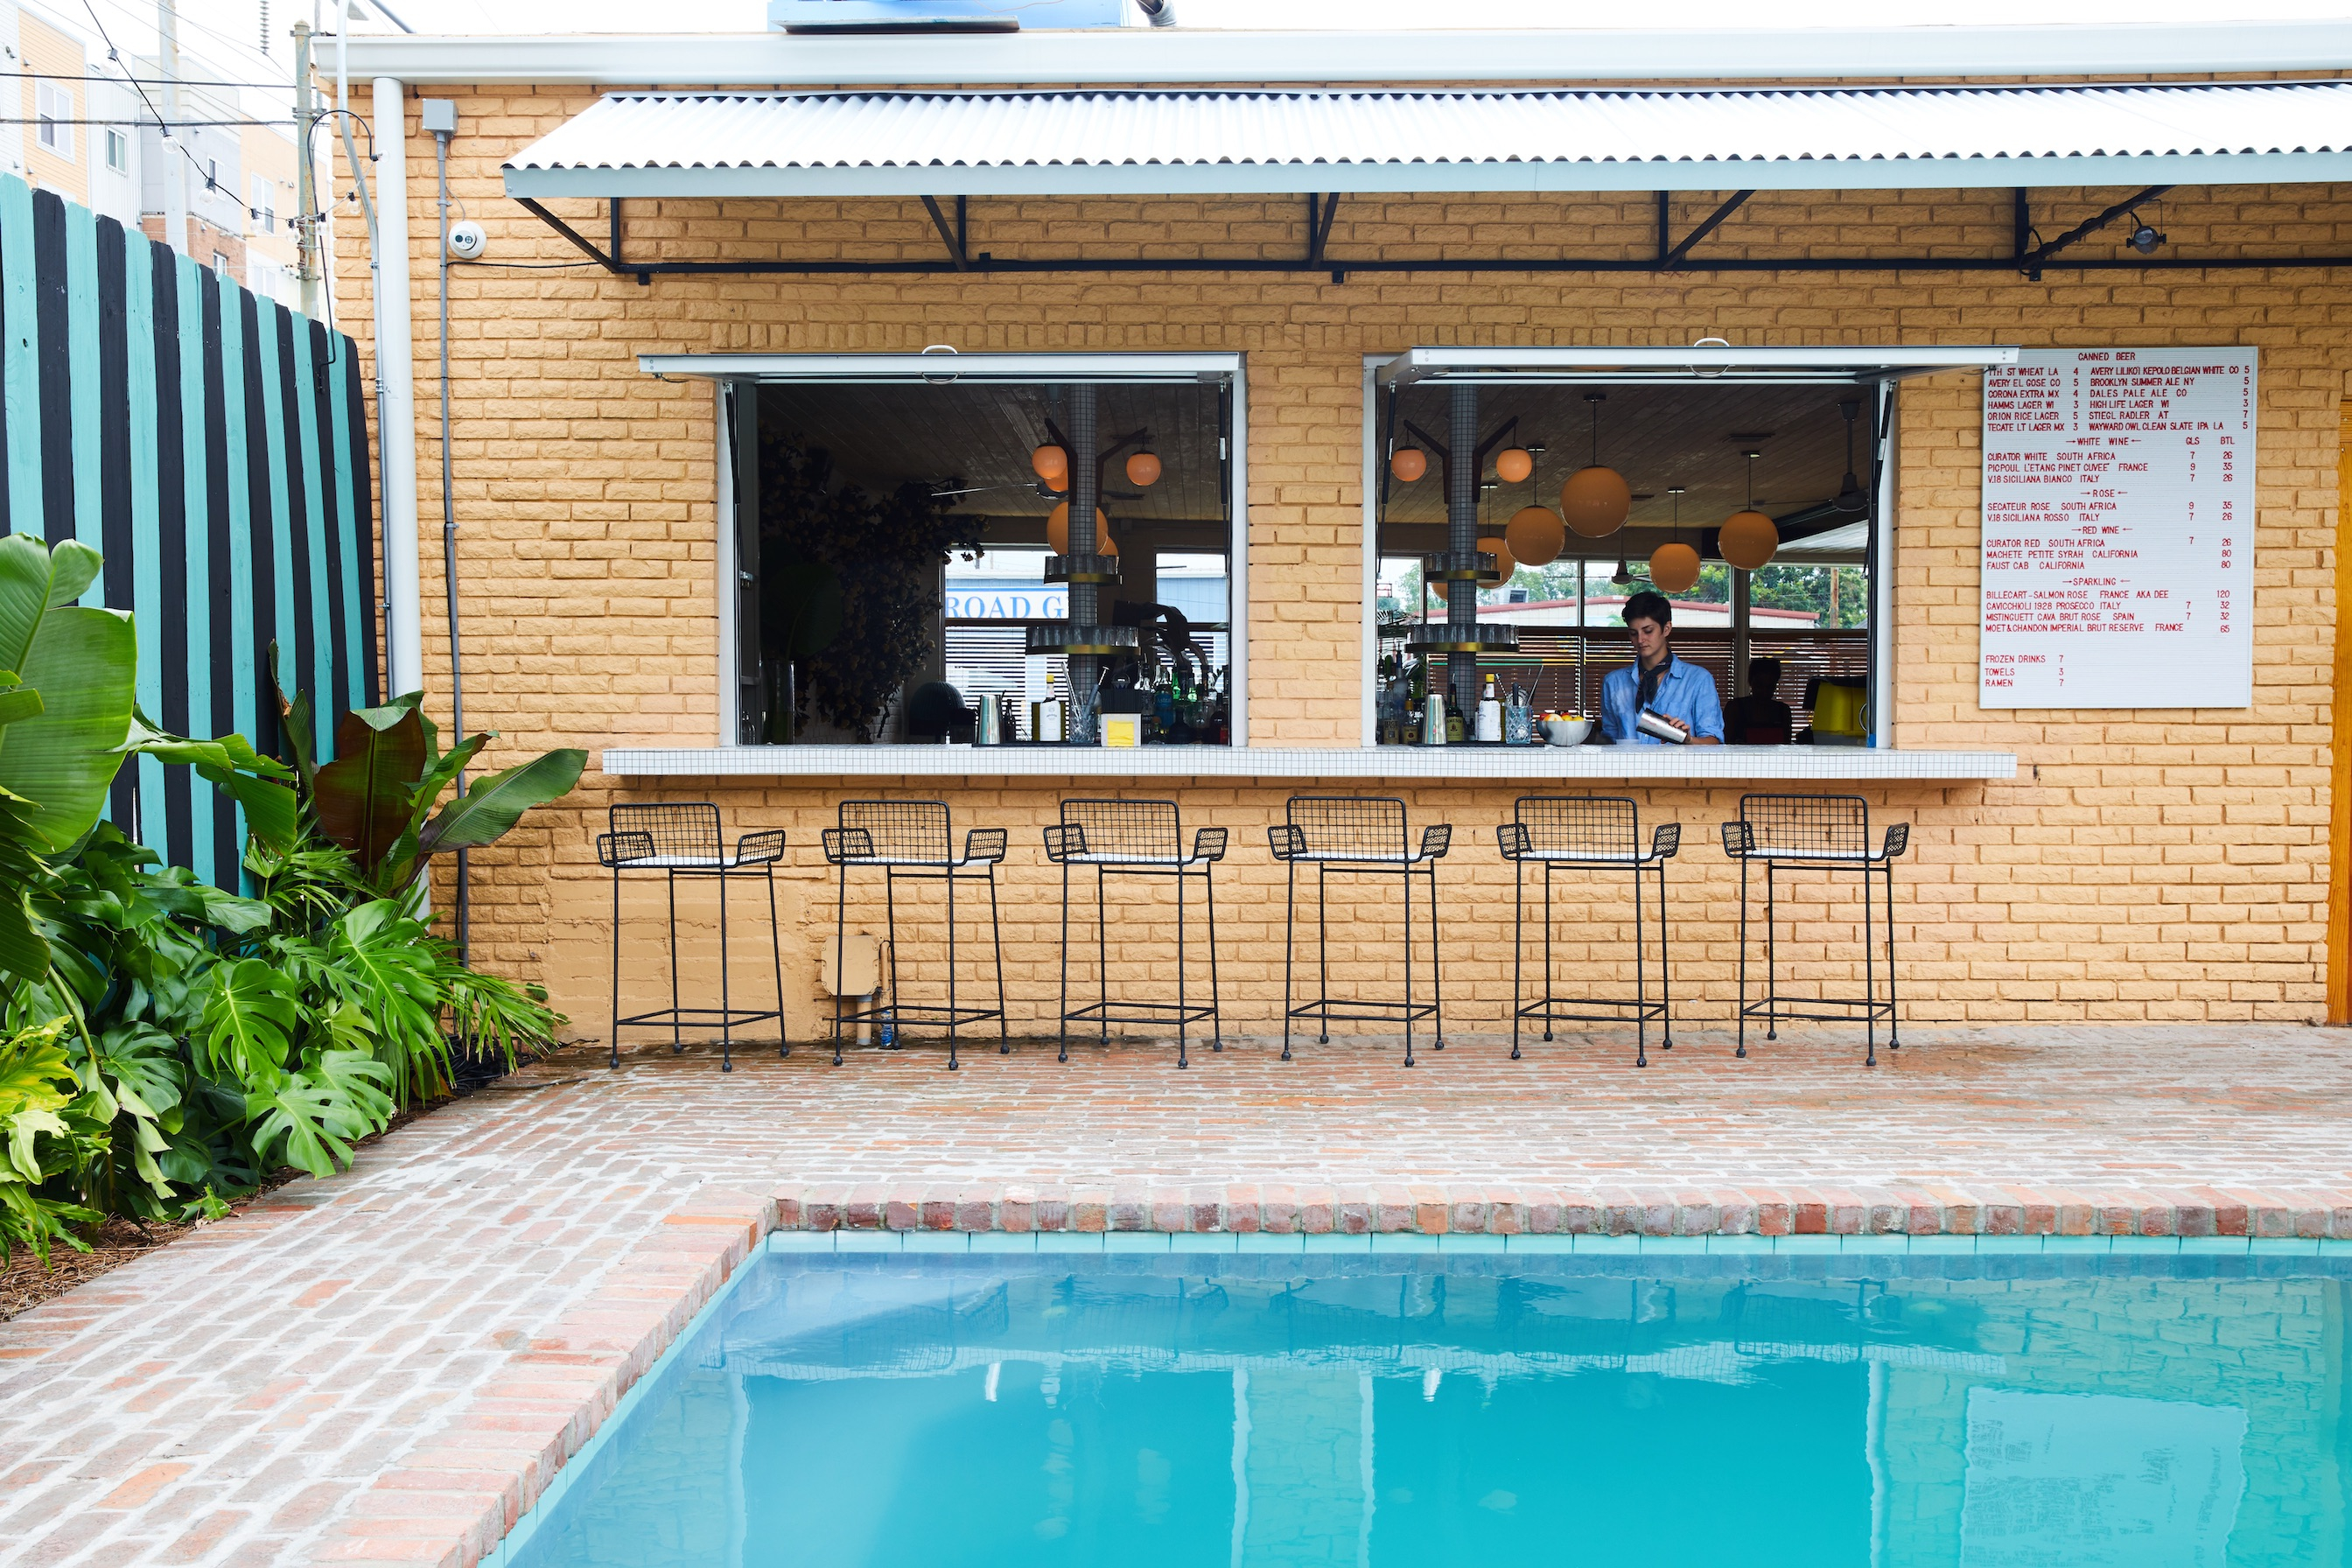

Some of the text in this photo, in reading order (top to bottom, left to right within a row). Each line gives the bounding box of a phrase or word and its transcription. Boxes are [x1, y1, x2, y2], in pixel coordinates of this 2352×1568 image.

[2116, 352, 2135, 360] BEER
[2090, 367, 2114, 375] AVERY
[2074, 378, 2078, 387] 5
[2090, 378, 2127, 387] BROOKLYN
[2165, 377, 2180, 386] ALE
[2244, 376, 2250, 385] 5
[2020, 389, 2045, 398] EXTRA
[2124, 388, 2146, 397] PALE
[2151, 388, 2167, 397] ALE
[2109, 400, 2126, 409] LIFE
[2034, 411, 2059, 420] LAGER
[2073, 411, 2078, 420] 5
[2158, 410, 2169, 419] AT
[2029, 423, 2051, 431] LAGER
[2142, 422, 2166, 430] CLEAN
[2243, 421, 2248, 430] 5
[1988, 452, 2020, 461] CURATOR
[1988, 502, 2026, 511] SECATEUR
[2079, 513, 2099, 522] ITALY
[1986, 539, 2022, 548] CURATOR
[2092, 550, 2138, 558] CALIFORNIA
[2040, 561, 2084, 570] CALIFORNIA
[2154, 590, 2168, 598] DEE
[2109, 623, 2144, 632] RESERVE
[2019, 654, 2046, 663] DRINKS
